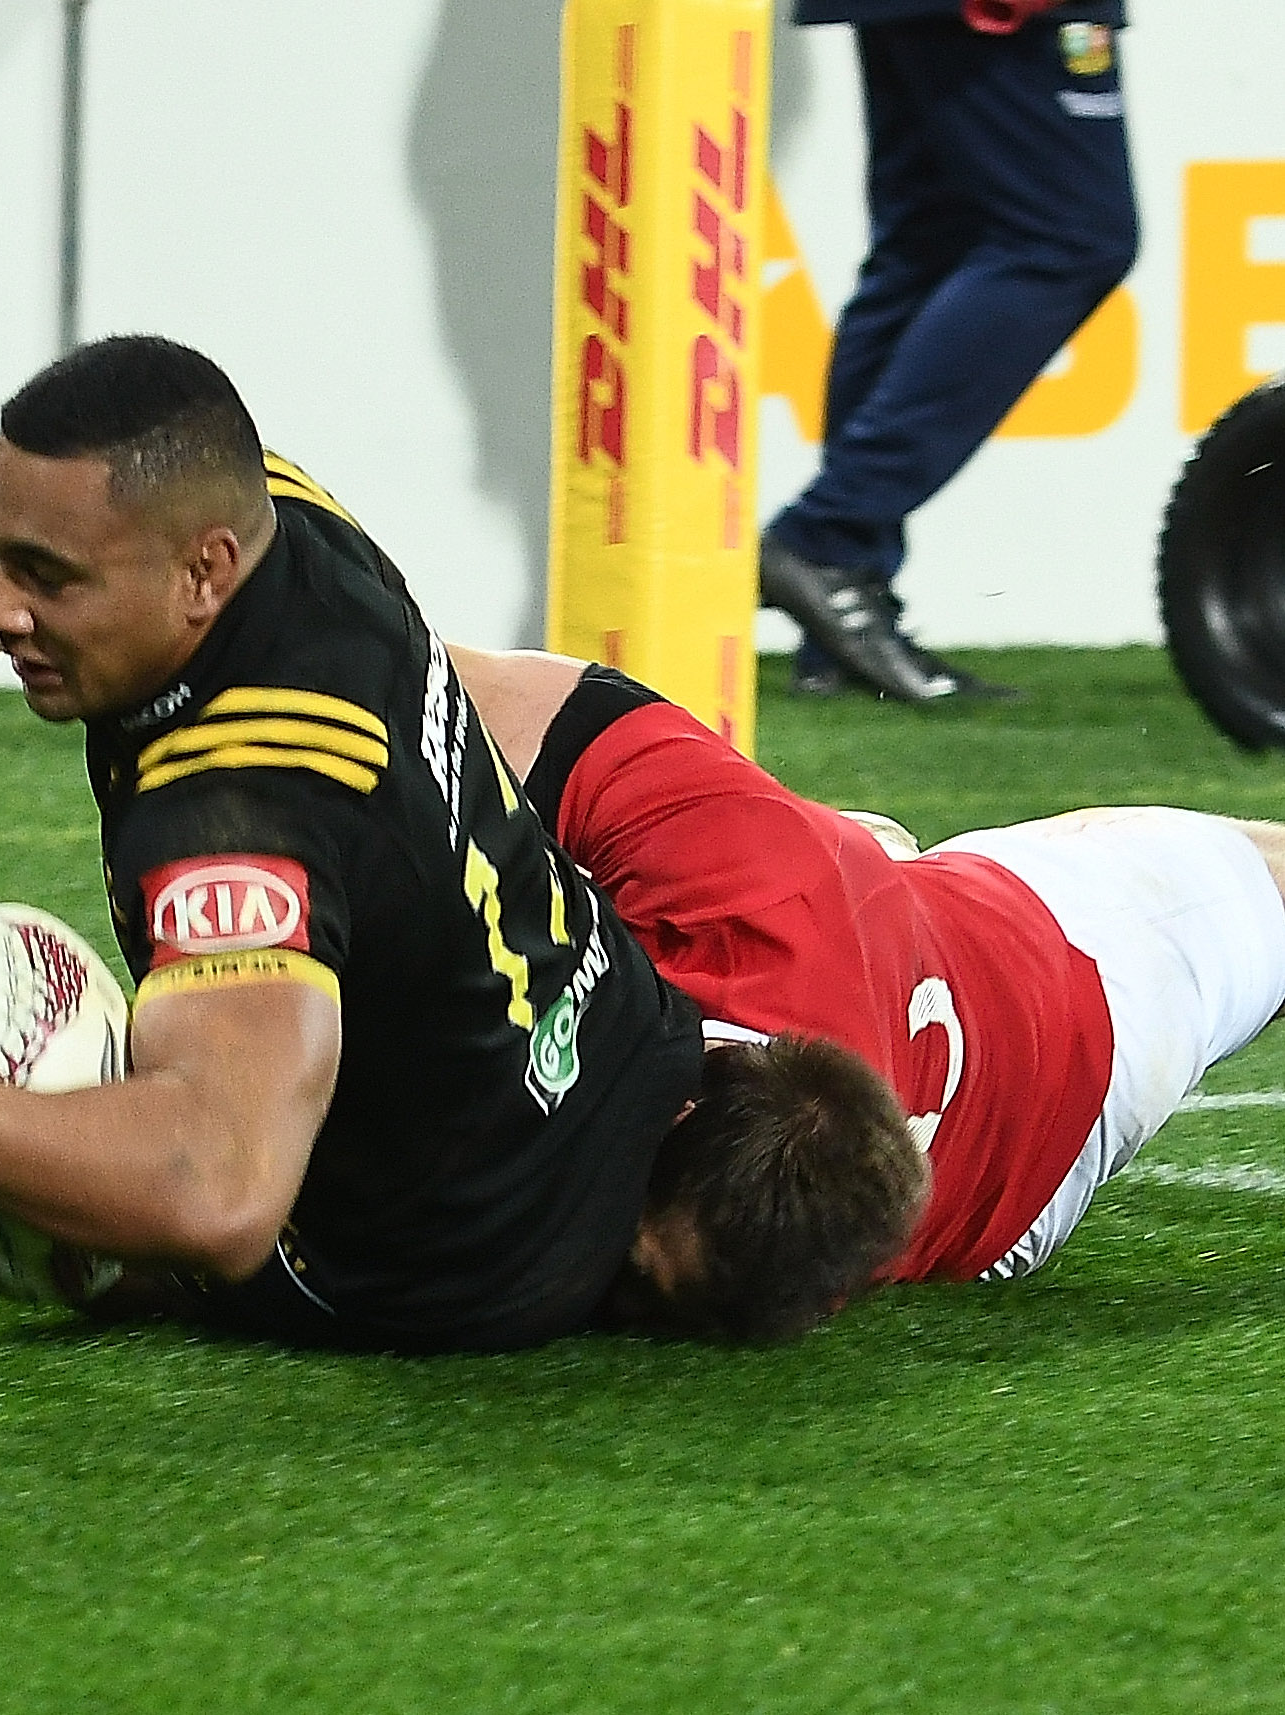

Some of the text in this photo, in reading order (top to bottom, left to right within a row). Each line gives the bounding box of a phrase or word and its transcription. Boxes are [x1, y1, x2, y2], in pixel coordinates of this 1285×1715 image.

[578, 103, 632, 468] DHL
[688, 109, 747, 473] DHL
[172, 884, 280, 942] KIA
